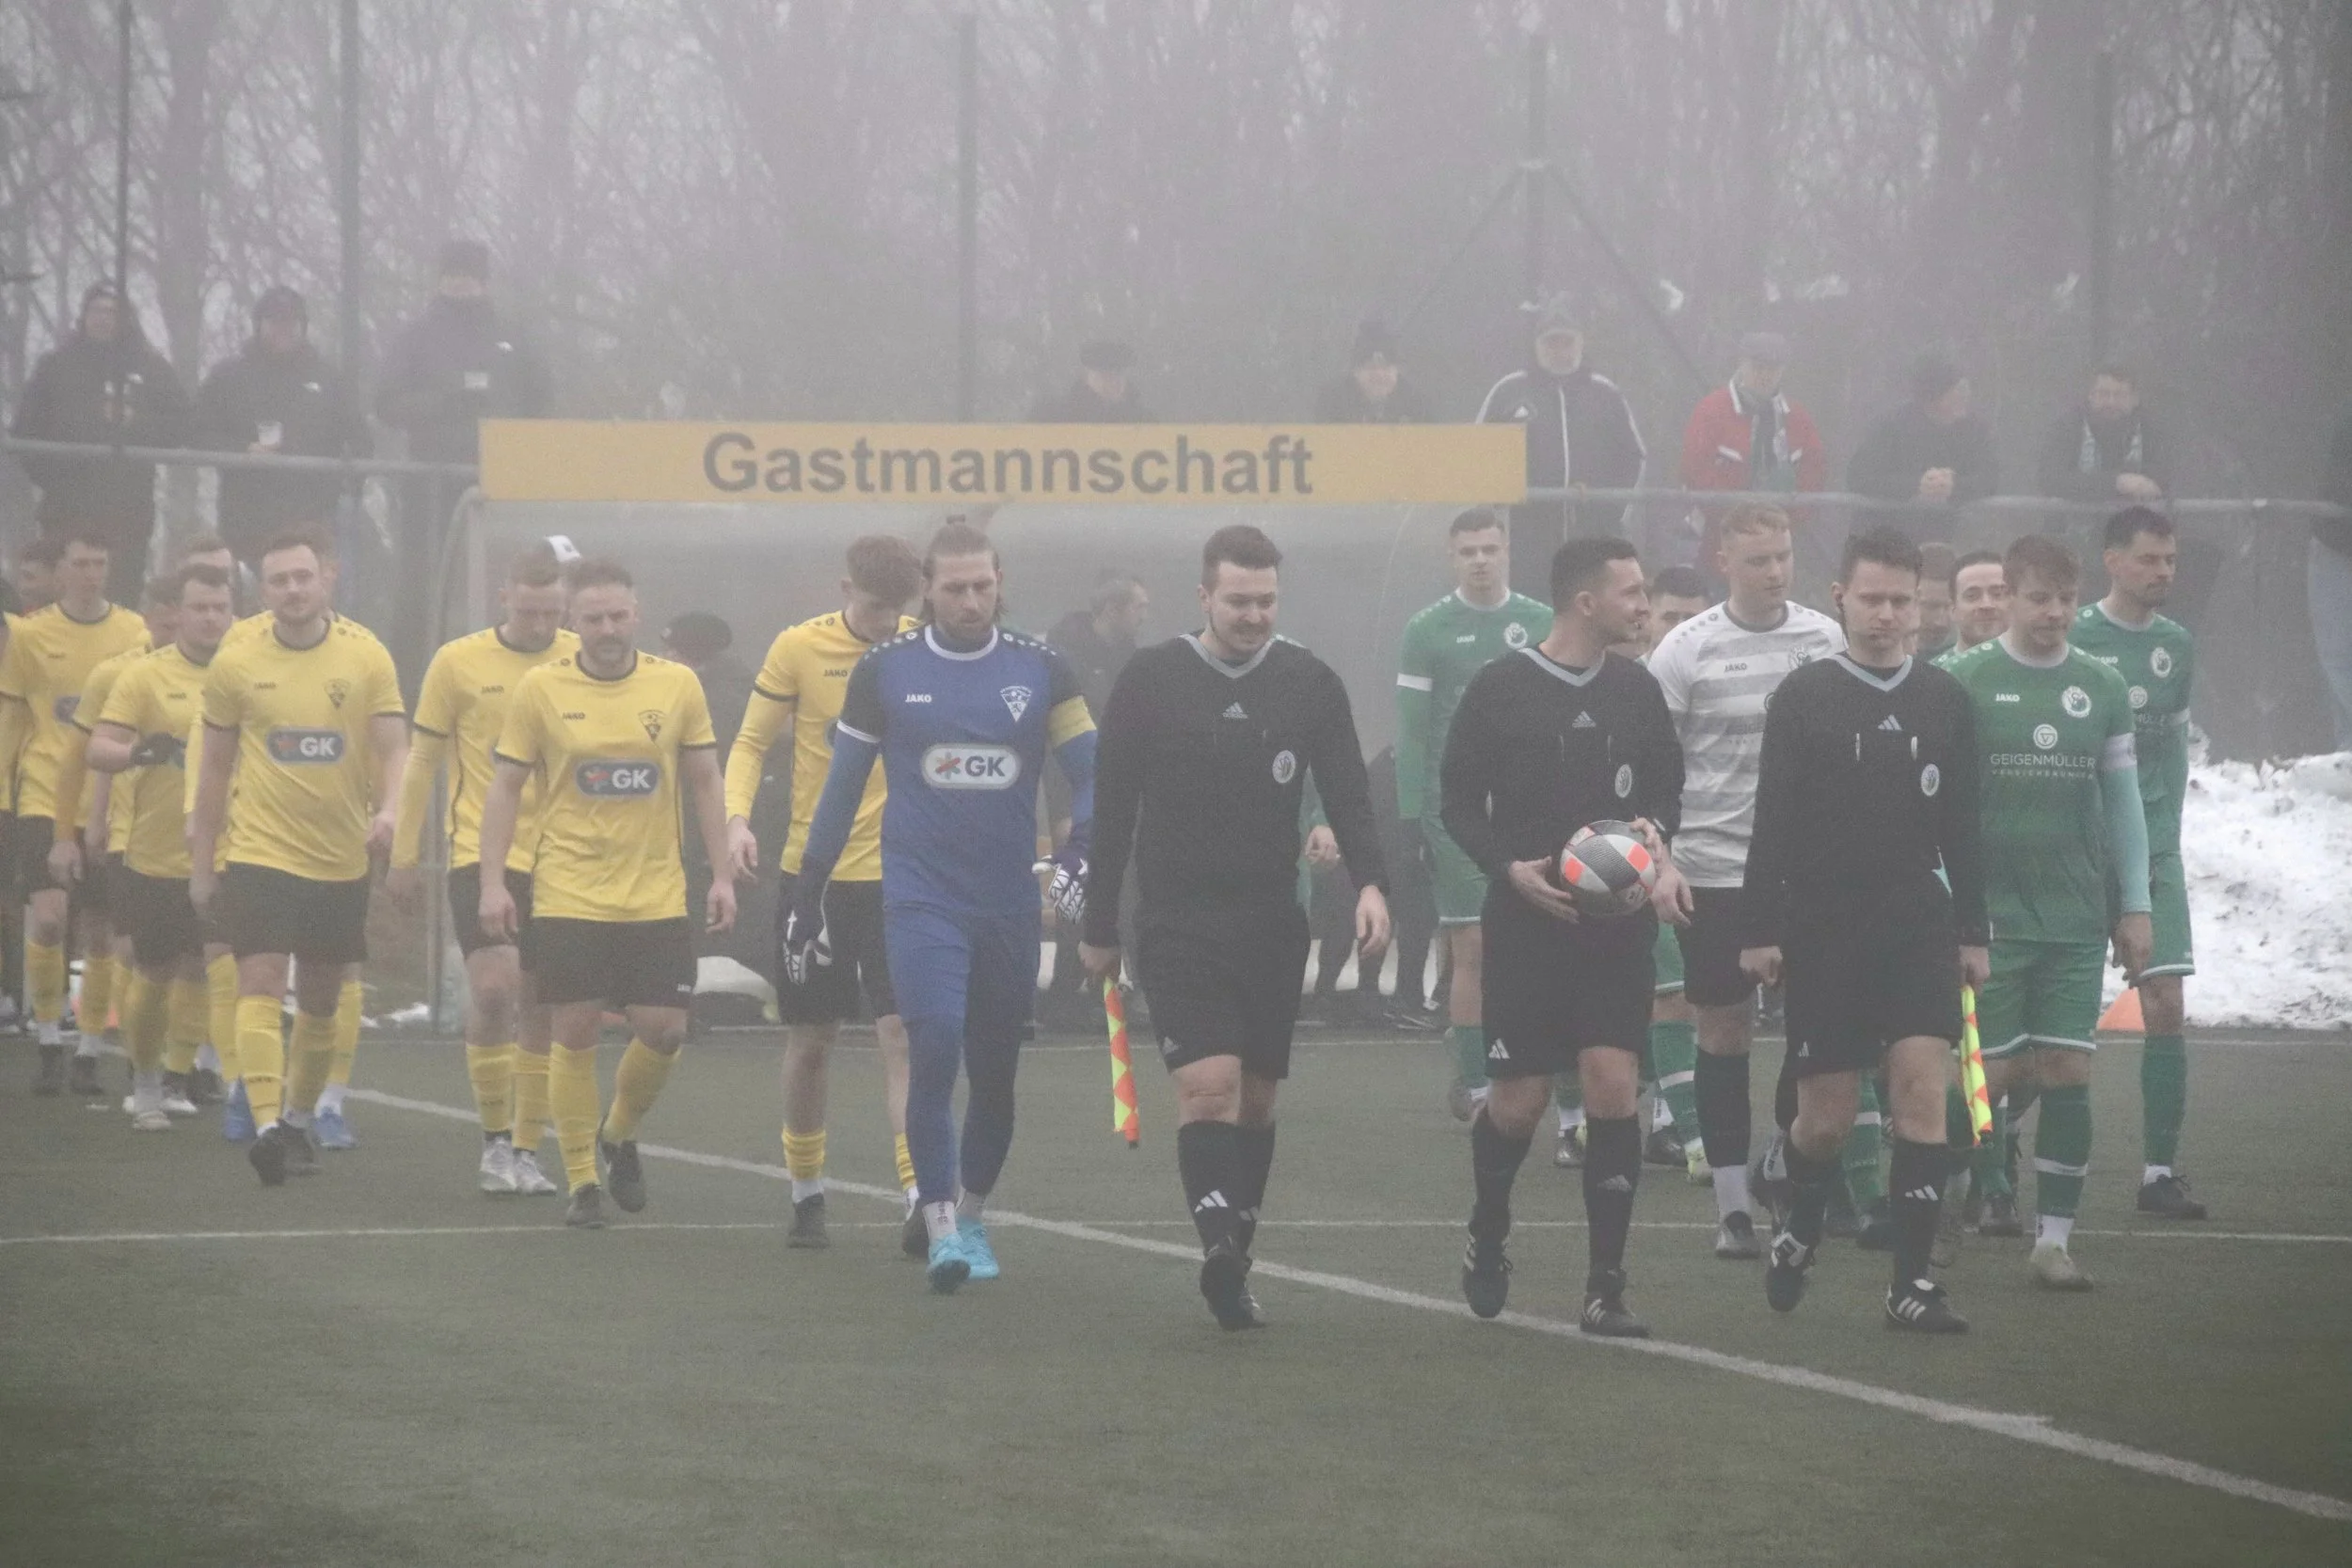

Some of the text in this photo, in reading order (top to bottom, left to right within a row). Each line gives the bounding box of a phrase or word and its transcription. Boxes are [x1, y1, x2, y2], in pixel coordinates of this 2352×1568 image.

[702, 432, 1313, 495] Gastmannschaft
[823, 669, 848, 677] JAKO
[1724, 662, 1747, 673] JAKO
[905, 693, 932, 703] JAKO
[1995, 693, 2020, 703] JAKO
[299, 736, 335, 757] GK
[964, 755, 1006, 778] GK
[1990, 752, 2097, 768] GEIGENMÜLLER
[612, 768, 651, 789] GK
